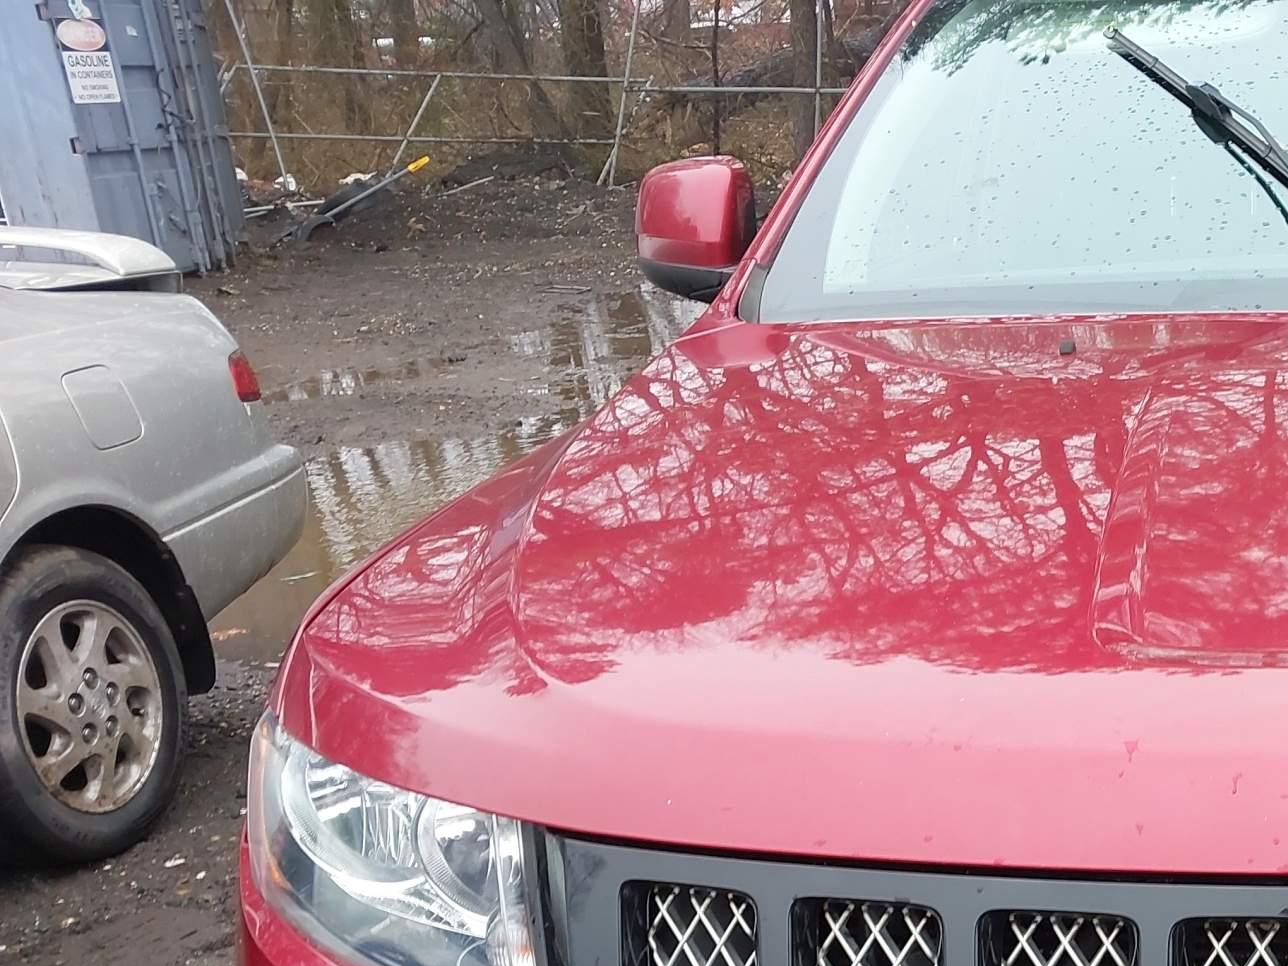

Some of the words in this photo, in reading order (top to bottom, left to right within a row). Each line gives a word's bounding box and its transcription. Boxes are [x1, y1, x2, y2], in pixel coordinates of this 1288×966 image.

[68, 55, 110, 67] GASOLINE
[70, 71, 77, 79] IN
[77, 70, 113, 79] CONTAINERS
